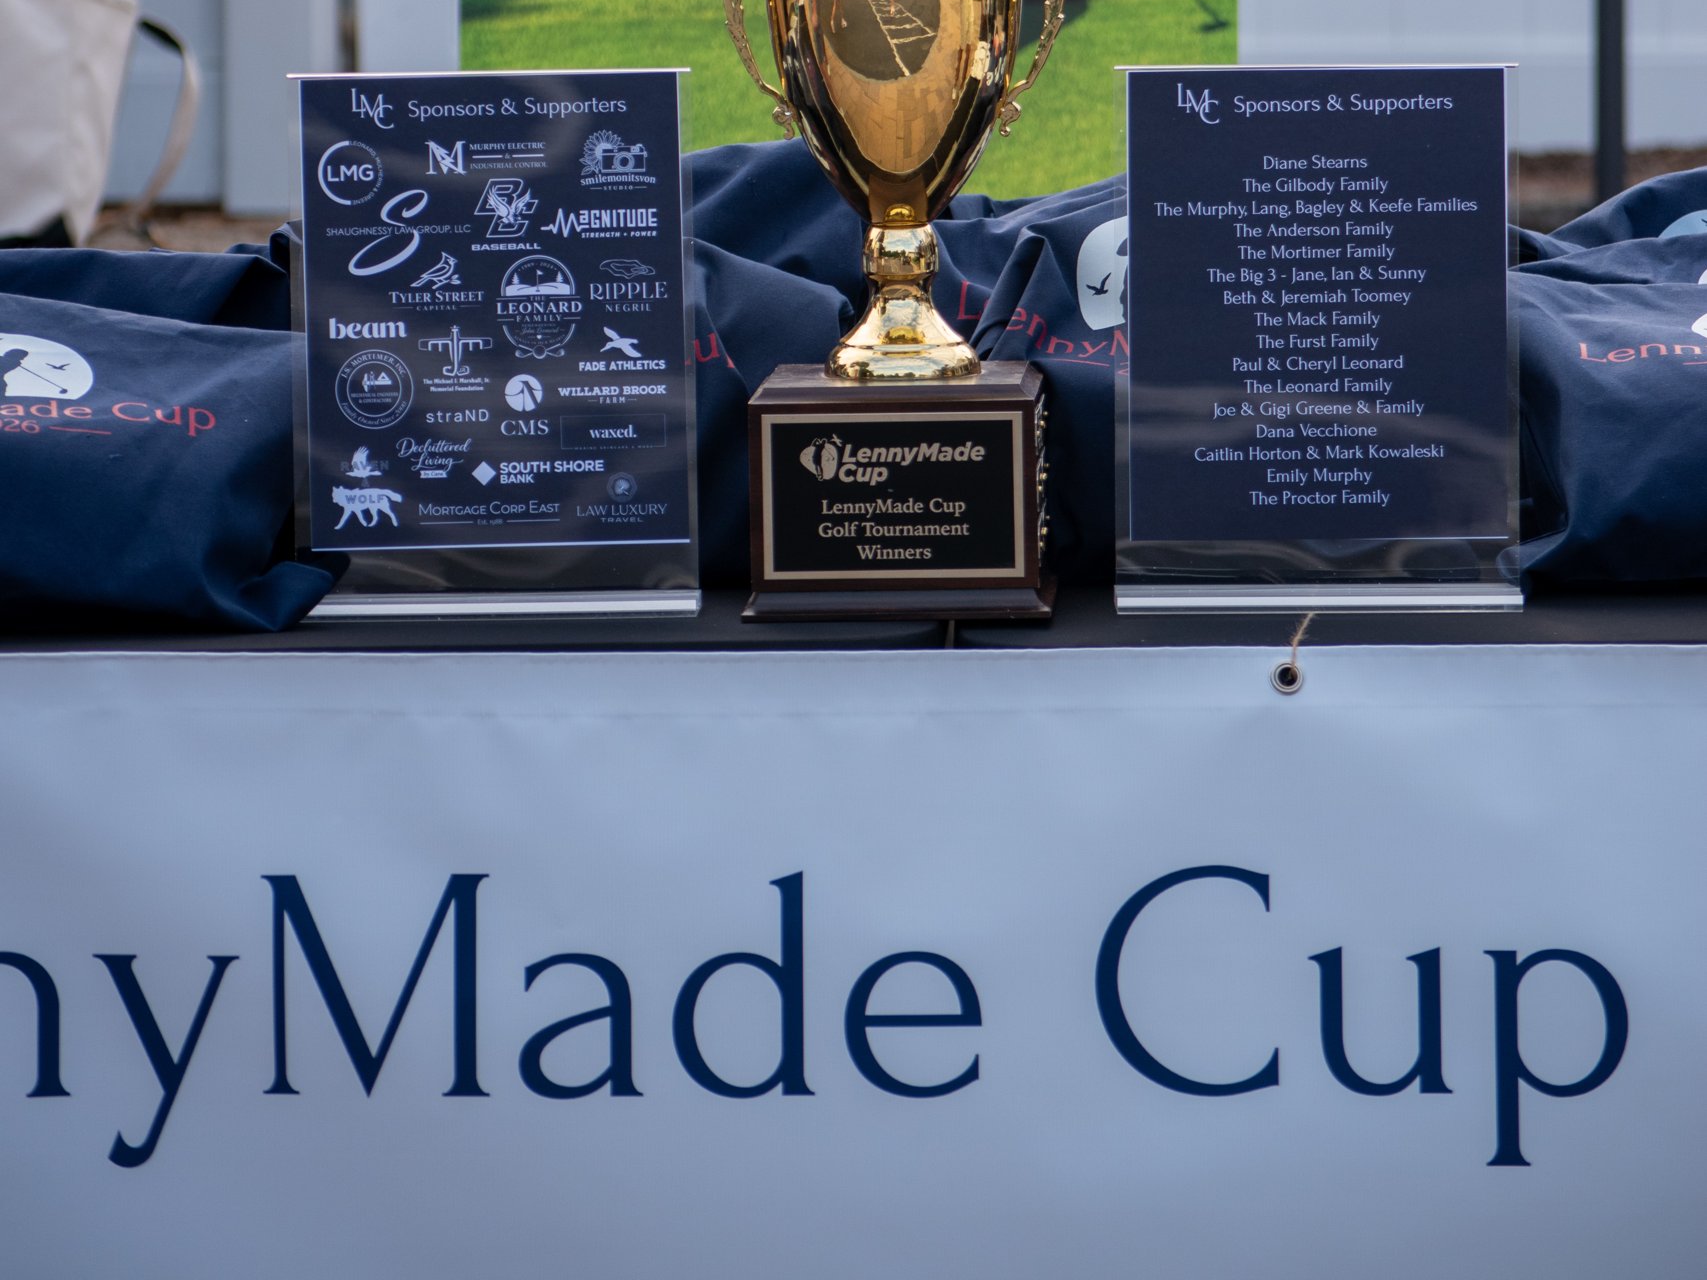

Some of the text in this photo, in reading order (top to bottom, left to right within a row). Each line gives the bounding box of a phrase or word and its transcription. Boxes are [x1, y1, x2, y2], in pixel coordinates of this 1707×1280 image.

[408, 99, 495, 121] Sponsors
[501, 99, 518, 116] &
[524, 97, 626, 119] Supporters
[1234, 95, 1321, 117] Sponsors
[1326, 94, 1344, 111] &
[1350, 93, 1453, 115] Supporters
[470, 143, 506, 151] MURPHY
[470, 161, 548, 170] INDUSTRIAL CONTROL
[1263, 154, 1368, 171] Diane Stearns
[327, 165, 374, 182] LMG
[580, 173, 656, 186] smilemonitsvon
[1243, 176, 1389, 195] The Gilbody Family
[1154, 197, 1477, 219] The Murphy, Lang, Bagley & Keefe Families
[326, 226, 392, 237] SHAUGHNESSY
[394, 225, 415, 235] LAW
[454, 224, 471, 233] LLC
[1234, 220, 1393, 238] The Anderson Family
[471, 243, 541, 251] BASEBALL
[1238, 243, 1395, 261] The Mortimer Family
[1207, 268, 1235, 283] The
[1240, 267, 1263, 286] Big
[1267, 268, 1276, 282] 3
[1291, 267, 1327, 284] Jane,
[1331, 266, 1354, 280] Ian
[1359, 266, 1373, 280] &
[1378, 266, 1426, 284] Sunny
[589, 281, 667, 299] RIPPLE
[1223, 287, 1411, 307] Beth & Jeremiah Toomey
[416, 304, 458, 312] CAPITAL
[496, 301, 582, 315] LEONARD
[606, 302, 652, 312] NEGRIL
[516, 314, 562, 323] FAMILY
[1254, 311, 1380, 329] The Mack Family
[329, 318, 407, 339] beam
[1256, 333, 1379, 351] The Furst Family
[1578, 342, 1707, 363] Lenn
[579, 360, 666, 371] FADE ATHLETICS
[1232, 355, 1403, 373] Paul & Cheryl Leonard
[558, 385, 666, 396] WILLARD BROOK
[1244, 378, 1392, 395] The Leonard Family
[426, 409, 489, 423] straND
[1213, 399, 1425, 420] Joe & Gigi Greene & Family
[0, 419, 41, 434] 26
[112, 401, 216, 437] Cup
[500, 419, 549, 436] CMS
[589, 425, 637, 439] waxed.
[1256, 423, 1377, 439] Dana Vecchione
[396, 437, 472, 457] Decluttered
[842, 442, 985, 467] LennyMade
[1194, 444, 1444, 462] Caitlin Horton & Mark Kowaleski
[411, 452, 464, 472] Living
[500, 460, 604, 474] SOUTH SHORE
[500, 474, 534, 484] BANK
[838, 463, 888, 486] Cup
[1267, 468, 1372, 486] Emily Murphy
[345, 494, 385, 504] WOLF
[1250, 489, 1390, 507] The Proctor Family
[576, 503, 667, 517] LAW LUXURY
[822, 498, 966, 518] LennyMade Cup
[818, 521, 970, 538] Golf Tournament
[857, 545, 932, 560] Winners
[1093, 862, 1630, 1167] Cup
